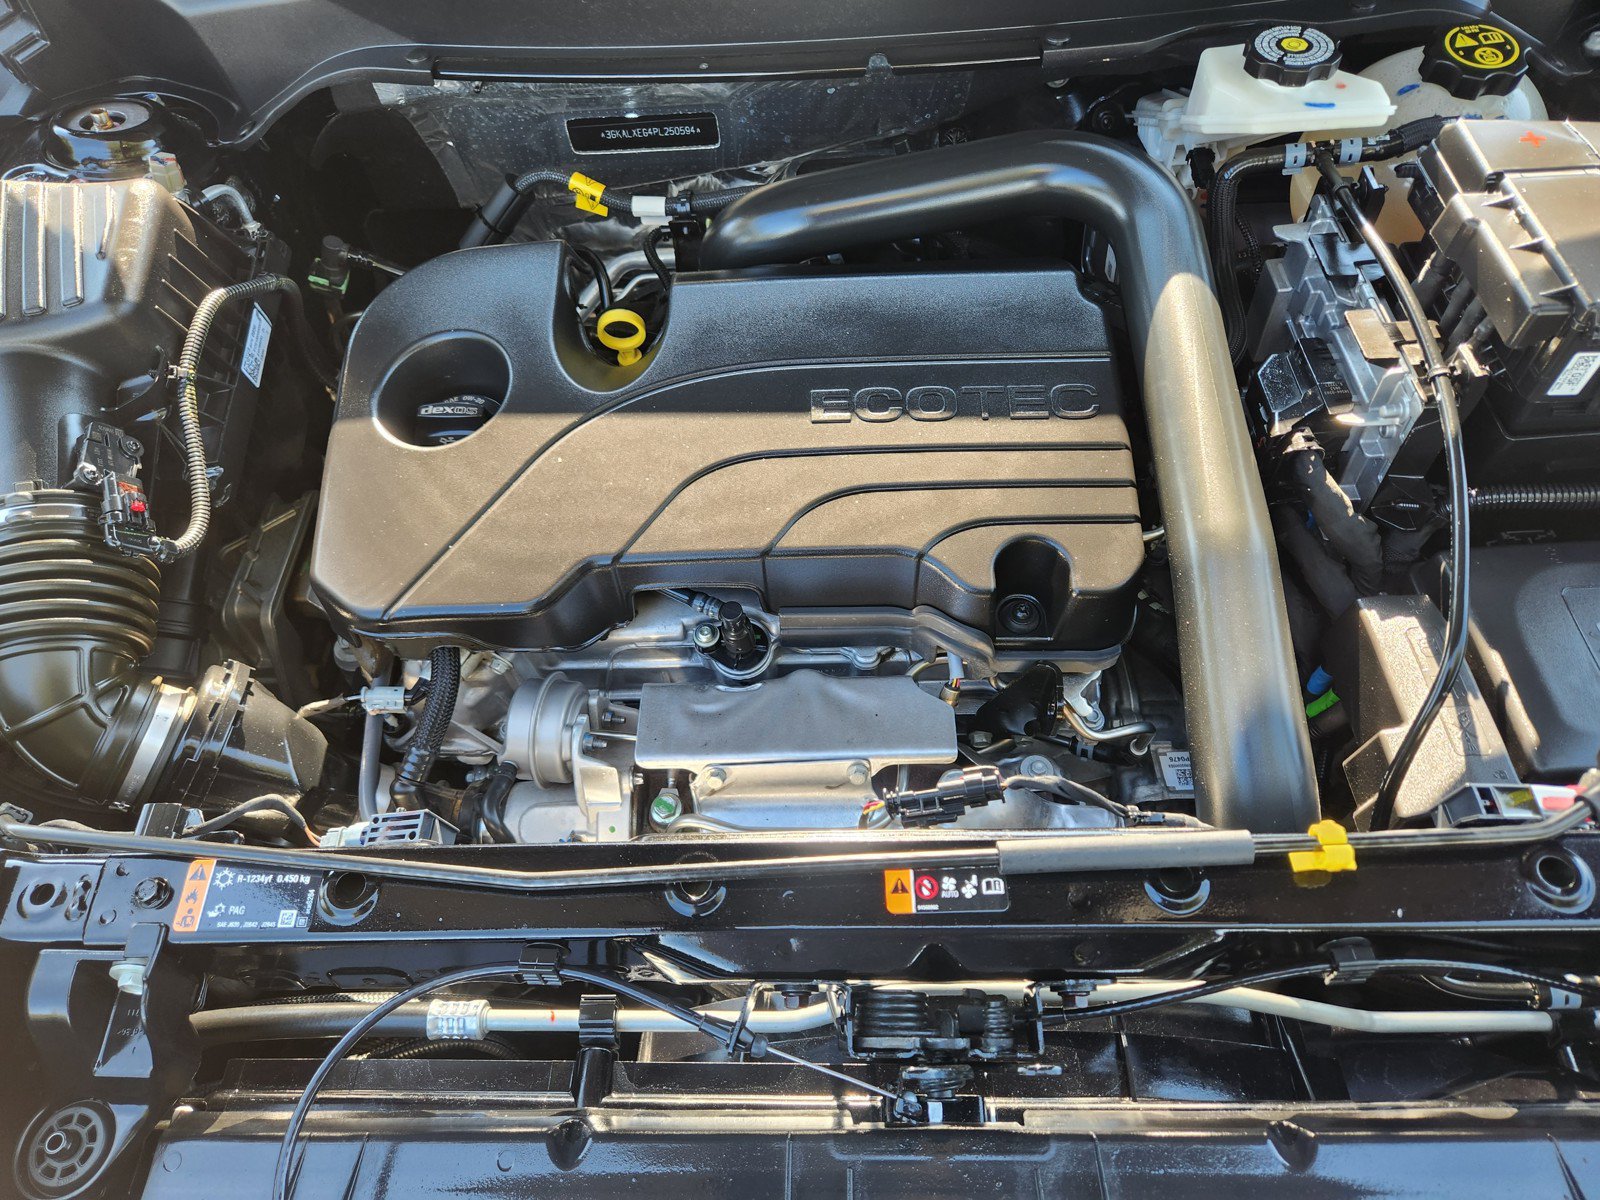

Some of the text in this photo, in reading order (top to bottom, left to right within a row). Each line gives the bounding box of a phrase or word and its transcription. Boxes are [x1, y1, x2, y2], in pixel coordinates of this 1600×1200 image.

[810, 383, 1100, 424] ECOTEC
[420, 405, 478, 415] dexos
[237, 874, 311, 885] R-1234yf 0.450 kg
[941, 890, 959, 899] AUTO
[228, 905, 246, 915] PAG
